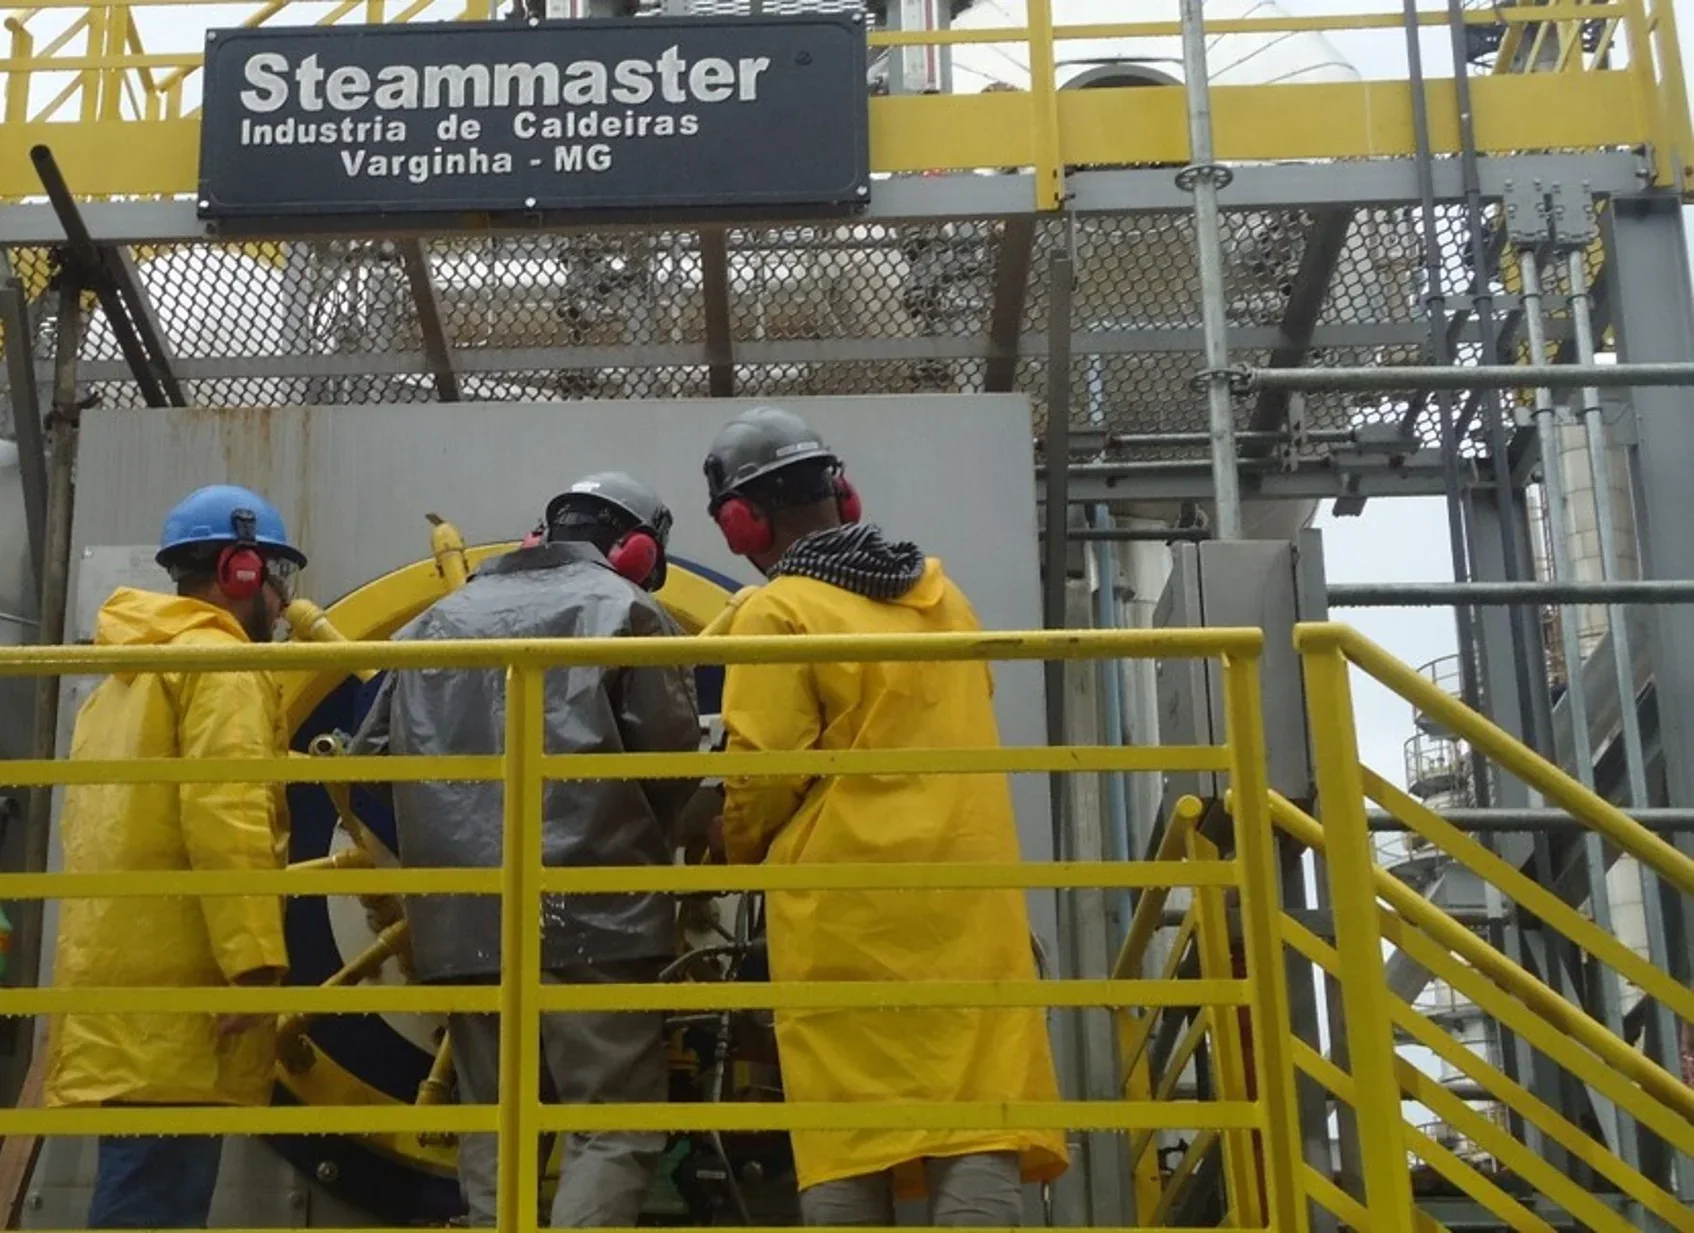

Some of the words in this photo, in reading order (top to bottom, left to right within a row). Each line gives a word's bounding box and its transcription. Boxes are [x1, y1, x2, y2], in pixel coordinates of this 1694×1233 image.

[240, 44, 771, 113] Steammaster
[241, 115, 406, 145] Industria
[436, 113, 481, 141] de
[513, 109, 699, 139] Caldeiras
[340, 146, 512, 183] Varginha
[554, 143, 612, 172] MG
